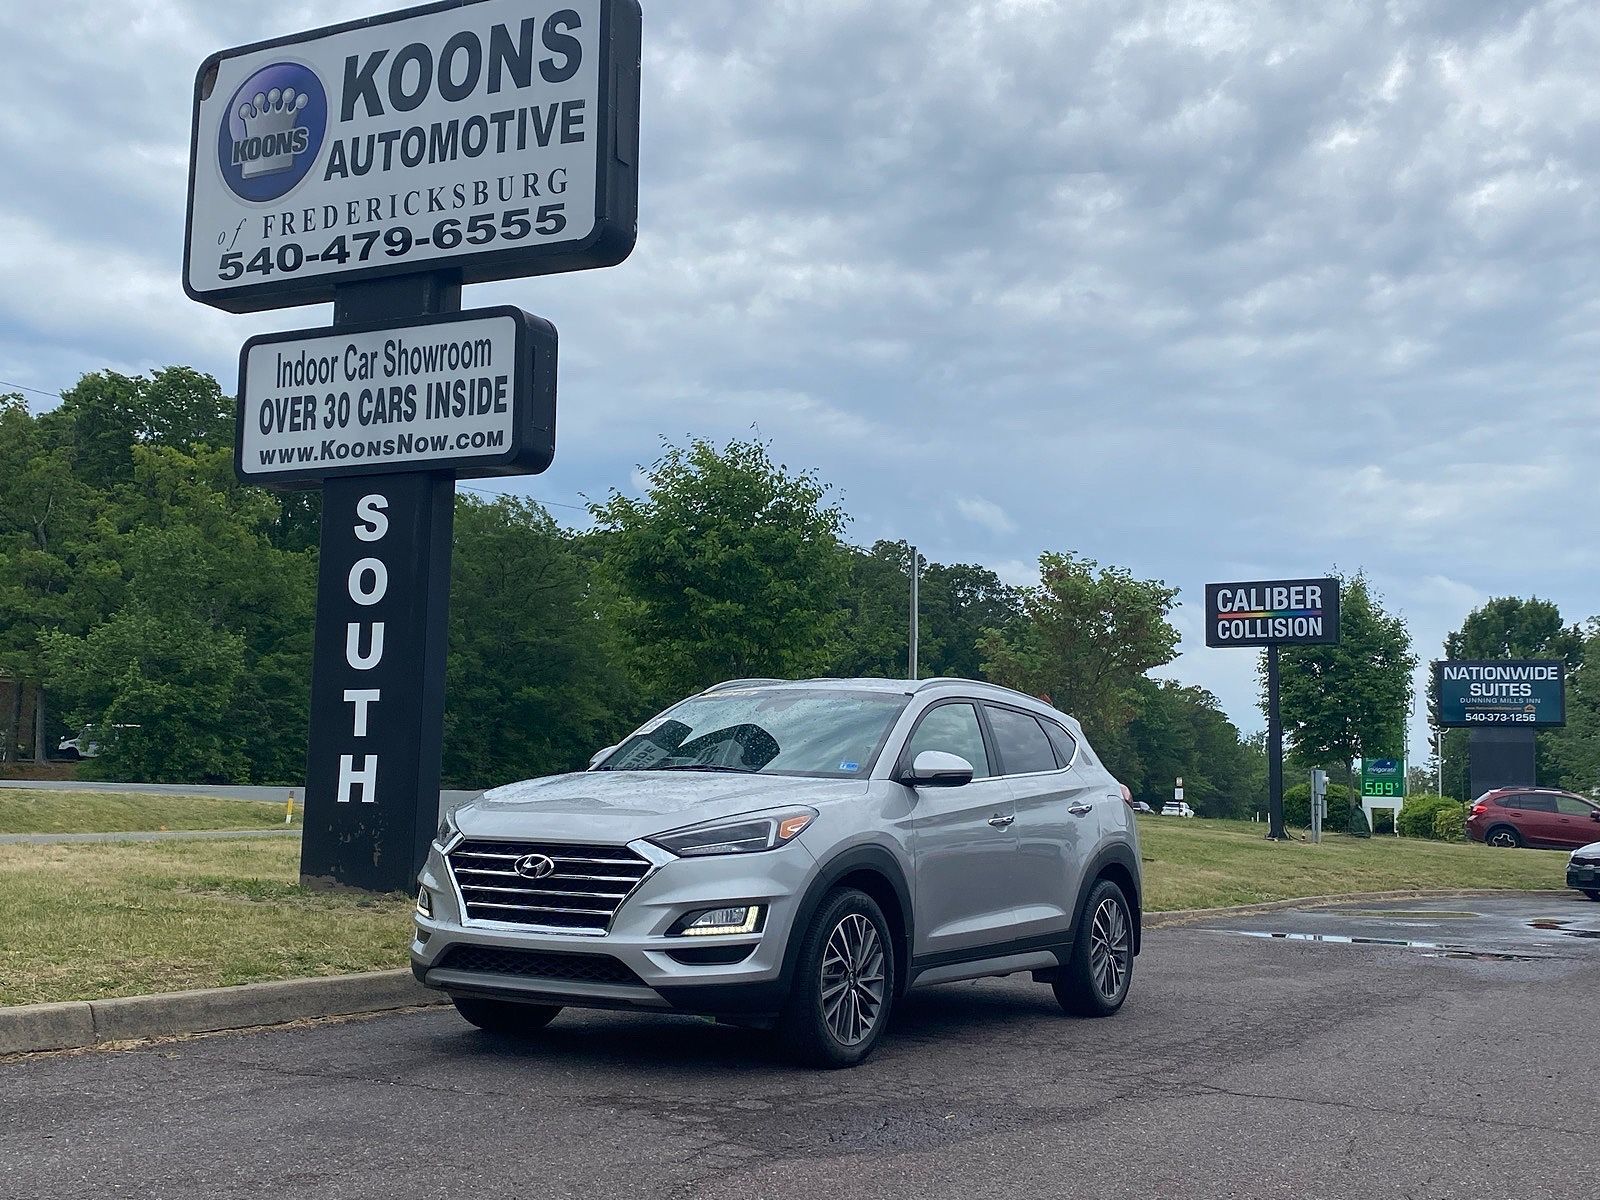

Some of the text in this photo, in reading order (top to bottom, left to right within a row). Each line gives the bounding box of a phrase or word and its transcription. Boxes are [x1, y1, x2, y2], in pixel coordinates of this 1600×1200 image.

[340, 9, 582, 122] KOONS
[233, 129, 307, 163] KOONS
[324, 99, 586, 181] AUTOMOTIVE
[218, 168, 568, 251] of FREDERICKSBURG
[218, 203, 567, 281] 540-479-6555
[276, 338, 492, 388] Indoor Car Showroom
[259, 375, 508, 436] OVER 30 CARS INSIDE
[1217, 585, 1322, 612] CALIBER
[337, 494, 390, 804] SOUTH
[1217, 617, 1323, 640] COLLISION
[1443, 666, 1558, 680] NATIONWIDE
[1469, 683, 1532, 697] SUITES
[1465, 713, 1536, 722] 540-373-1256
